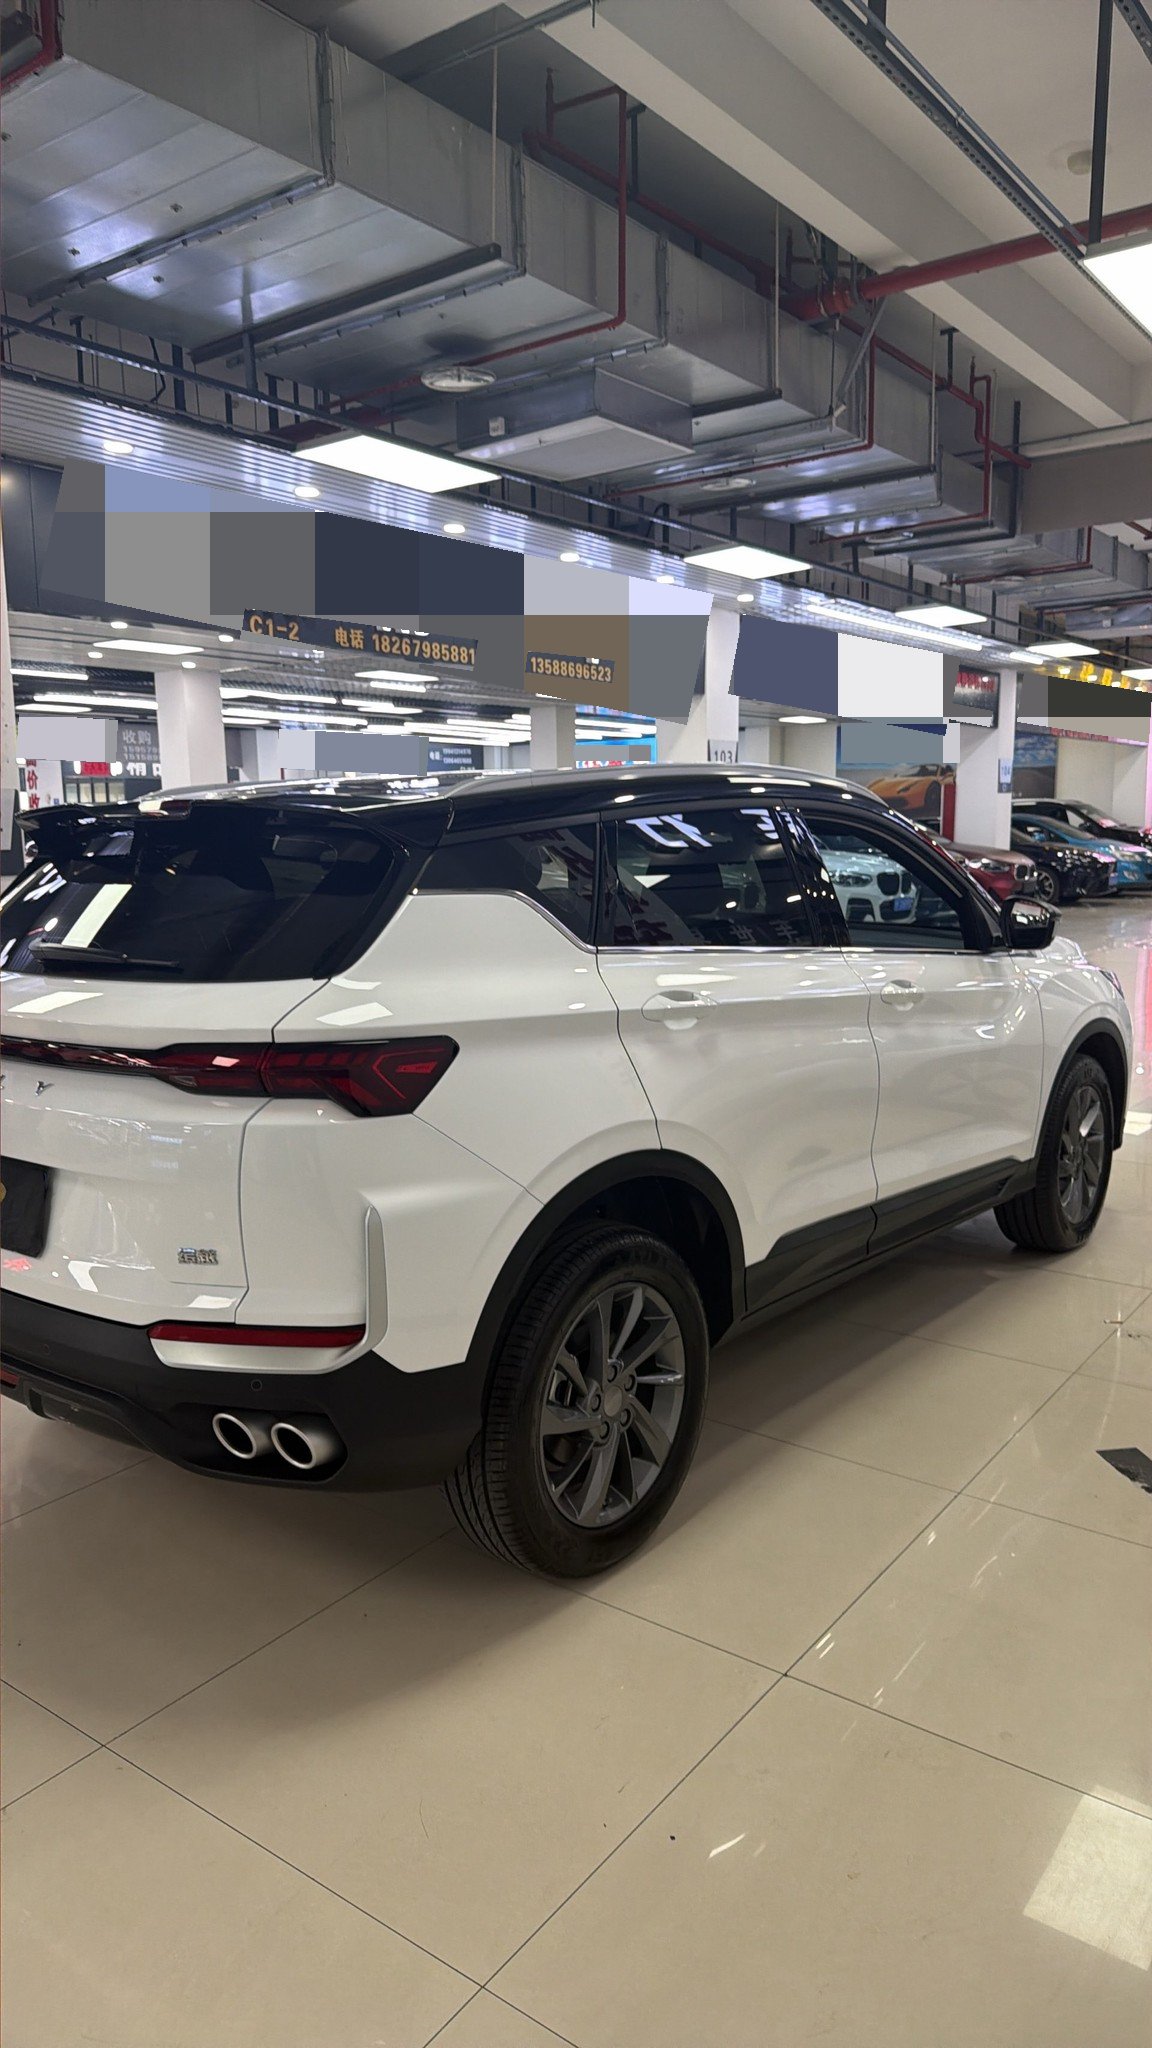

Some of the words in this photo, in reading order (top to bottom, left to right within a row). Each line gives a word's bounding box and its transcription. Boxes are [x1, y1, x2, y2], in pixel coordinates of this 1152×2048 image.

[249, 614, 300, 641] C1-2
[335, 626, 364, 650] 电话
[372, 633, 475, 665] 18267985881
[530, 656, 612, 682] 13588696523
